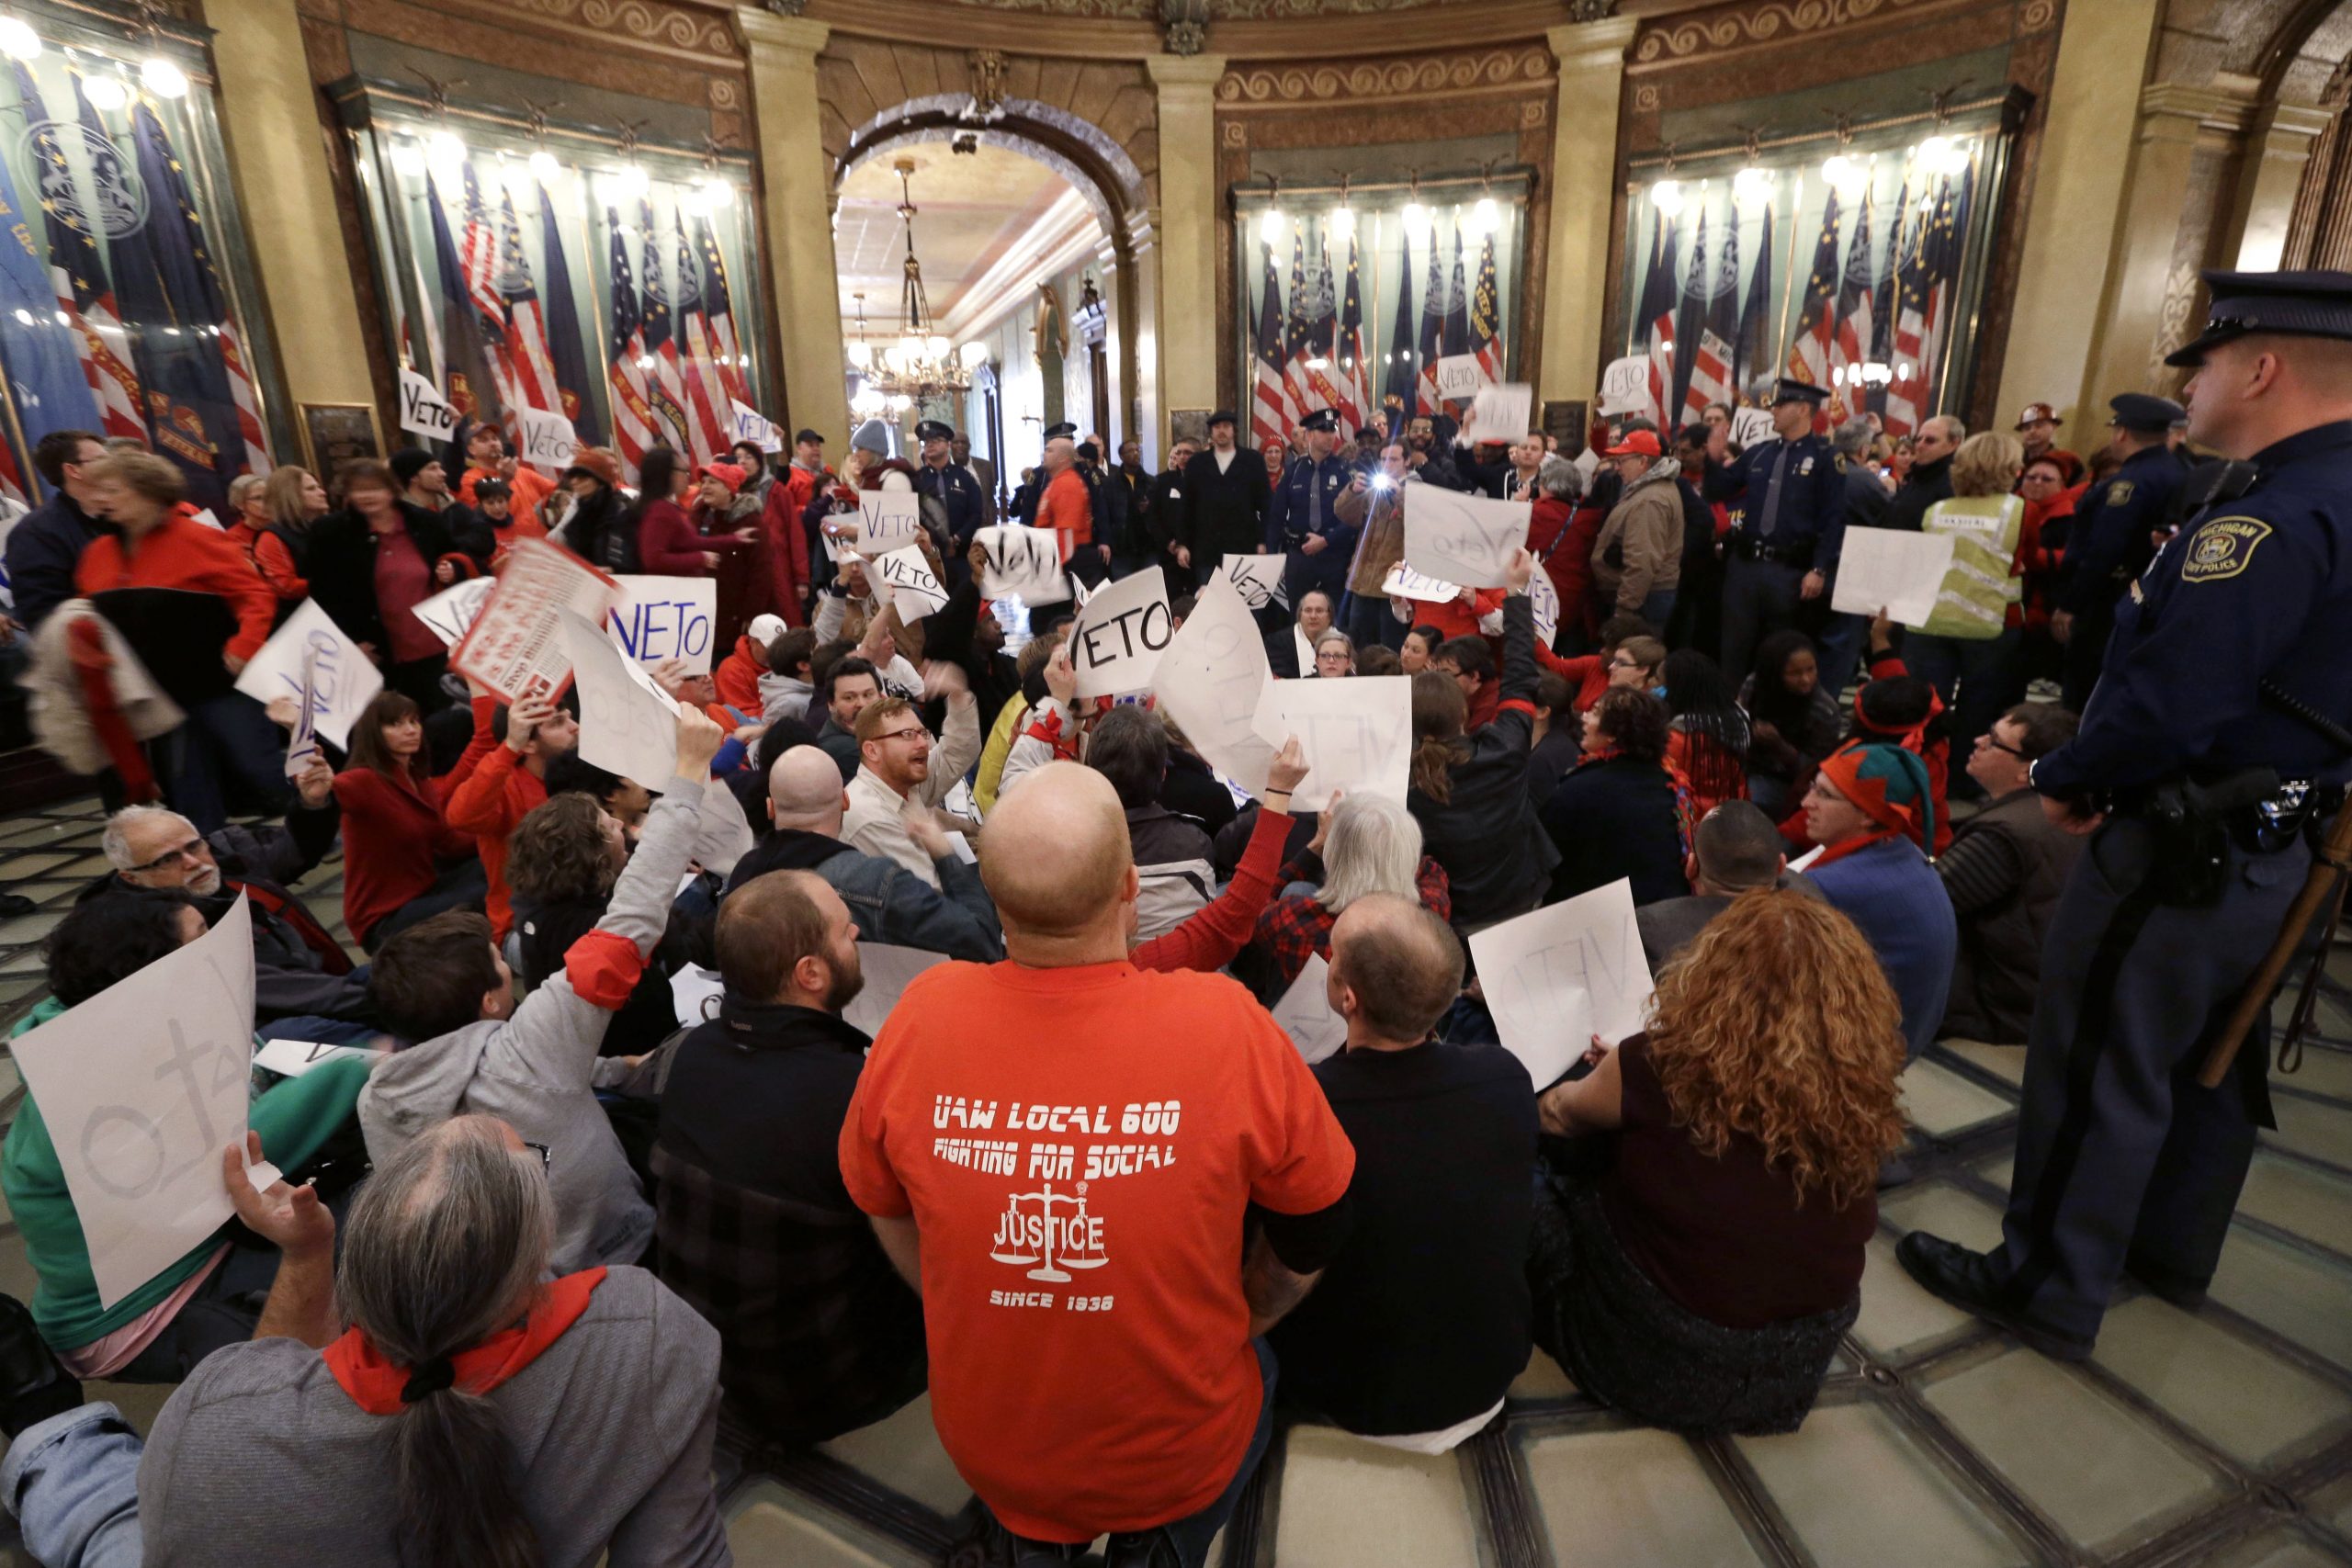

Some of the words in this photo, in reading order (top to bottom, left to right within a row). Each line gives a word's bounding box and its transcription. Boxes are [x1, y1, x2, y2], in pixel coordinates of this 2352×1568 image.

[402, 382, 453, 429] VETO
[1736, 413, 1774, 442] VET
[862, 500, 916, 539] VETO
[2199, 522, 2257, 539] MICHIGAN
[883, 556, 938, 590] VETO
[1230, 557, 1272, 606] VETO
[609, 601, 709, 661] VETO
[933, 1094, 999, 1130] UAW
[1006, 1102, 1112, 1134] LOCAL
[1121, 1100, 1182, 1136] 600
[933, 1137, 1019, 1177] FIGHTING
[1028, 1143, 1075, 1180] FOR
[1084, 1145, 1177, 1180] SOCIAL
[993, 1213, 1105, 1251] JUSTICE
[989, 1290, 1055, 1308] SINCE
